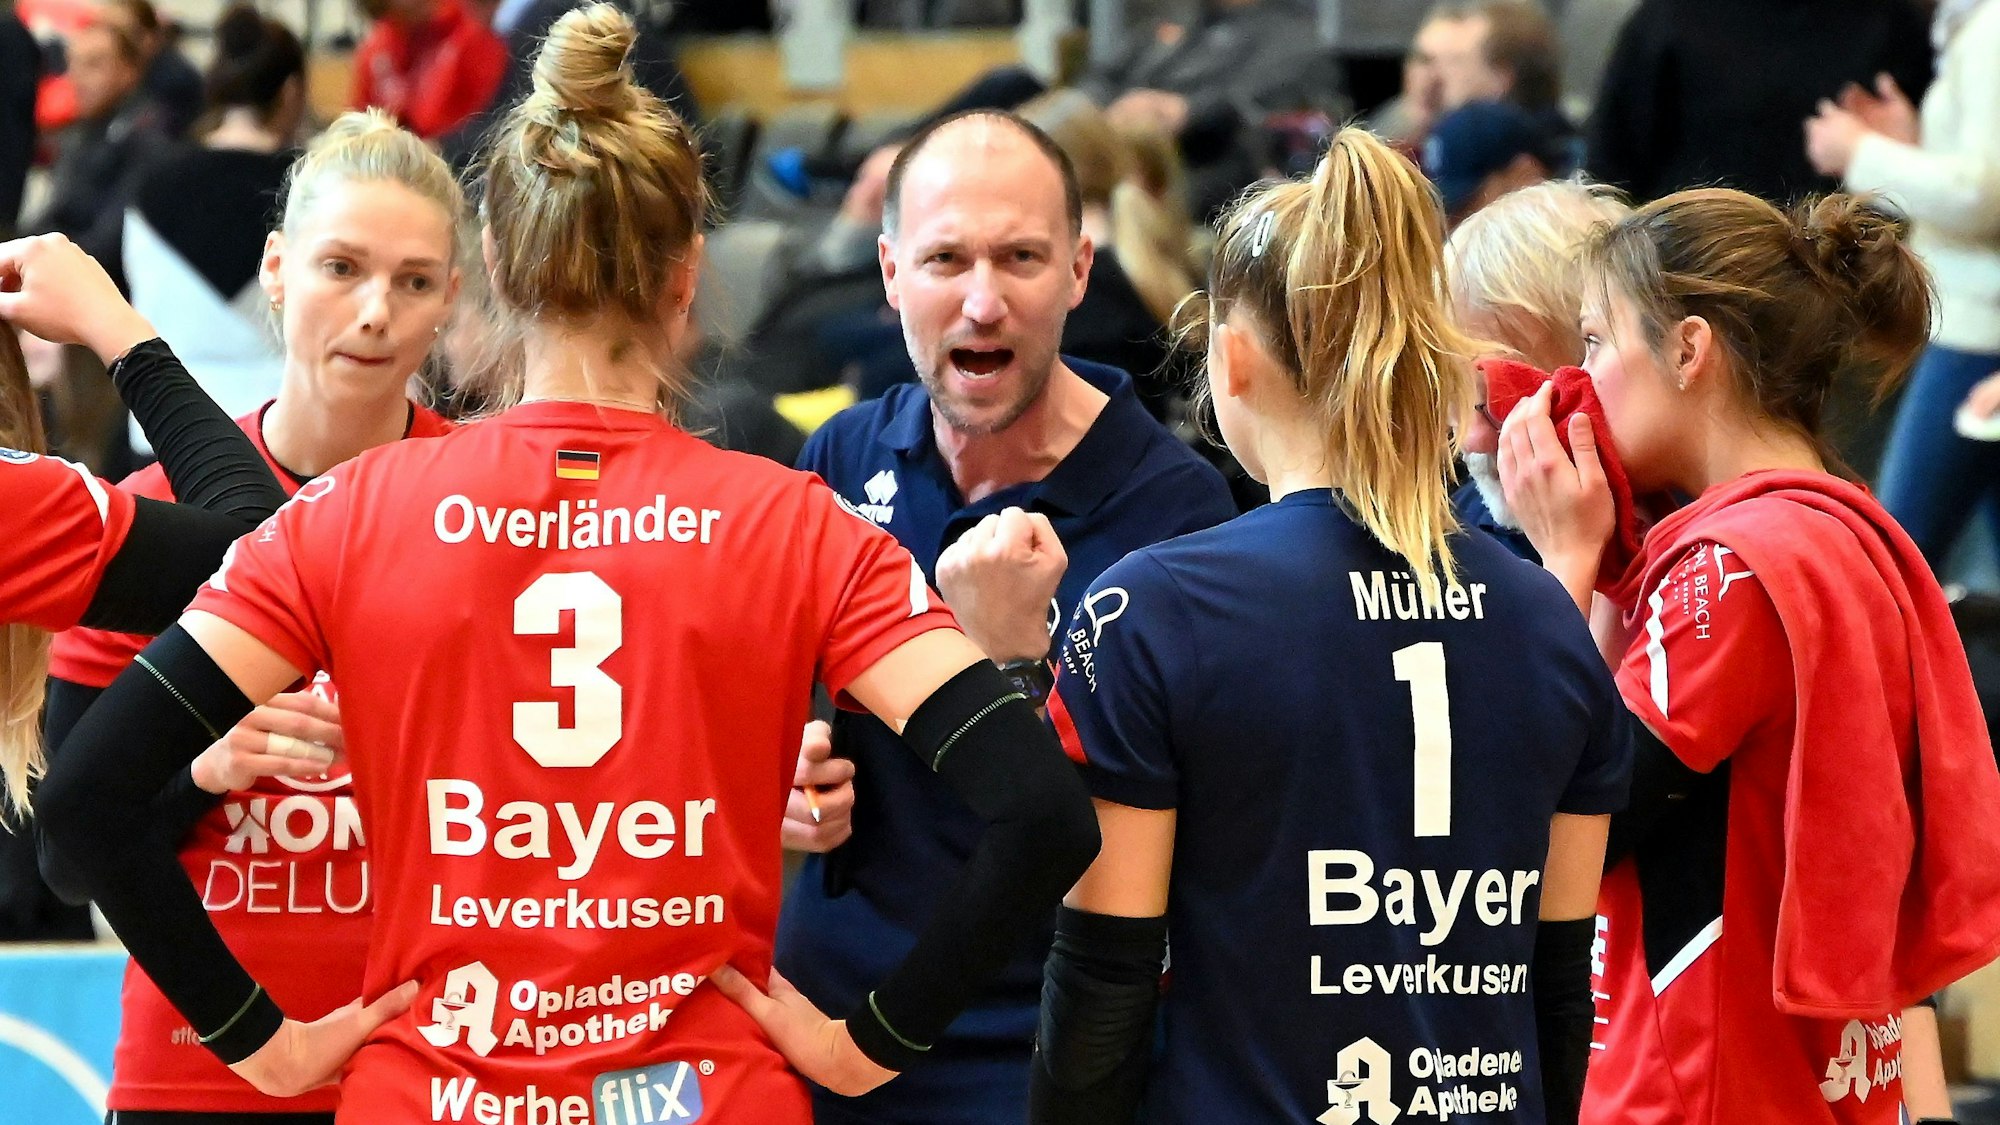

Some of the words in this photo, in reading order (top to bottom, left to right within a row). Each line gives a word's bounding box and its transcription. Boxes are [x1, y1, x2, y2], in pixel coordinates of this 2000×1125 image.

[434, 493, 722, 550] Overländer
[1348, 570, 1487, 620] Müller
[1694, 574, 1711, 640] BEACH
[512, 571, 623, 767] 3
[1071, 628, 1097, 693] BEACH
[1392, 641, 1452, 838] 1
[224, 795, 366, 854] HOM
[426, 778, 716, 880] Bayer
[202, 860, 370, 913] DELU
[429, 884, 724, 930] Leverkusen
[1307, 848, 1540, 946] Bayer
[1310, 955, 1528, 996] Leverkusen
[503, 1002, 674, 1055] Apothek
